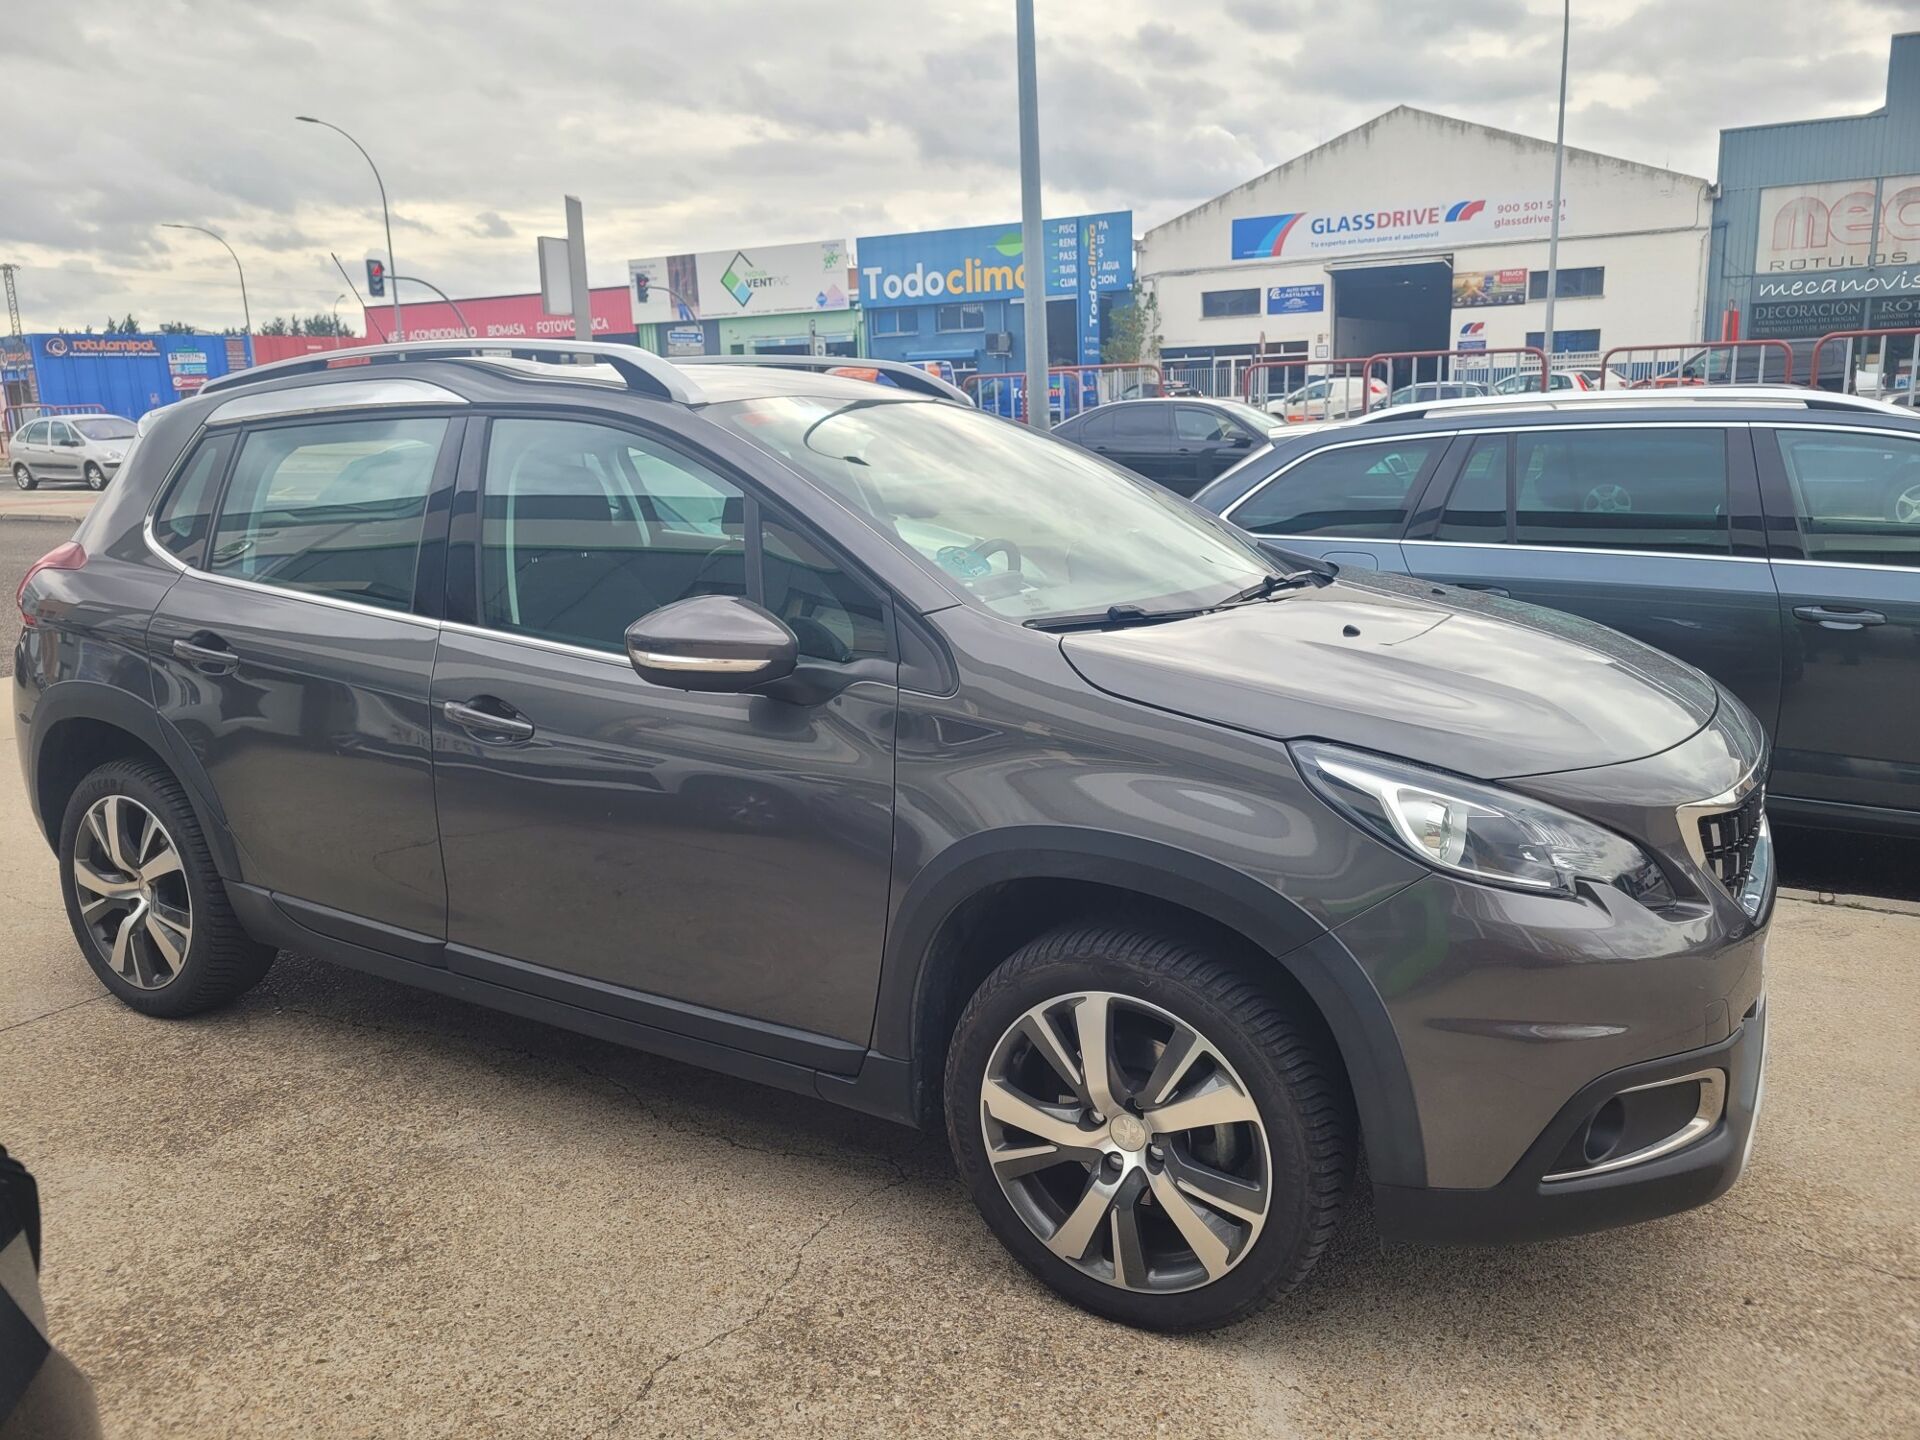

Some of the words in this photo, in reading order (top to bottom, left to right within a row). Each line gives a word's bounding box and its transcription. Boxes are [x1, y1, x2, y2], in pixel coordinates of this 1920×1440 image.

[1497, 202, 1520, 214] 900
[1524, 200, 1543, 212] 501
[1546, 199, 1567, 210] 51
[1311, 207, 1440, 235] GLASSDRIVE
[1494, 213, 1566, 229] glassdrive.s
[1769, 252, 1908, 272] ROTULOS
[1755, 301, 1861, 320] DECORACIÓN
[486, 323, 526, 337] BIOMASA
